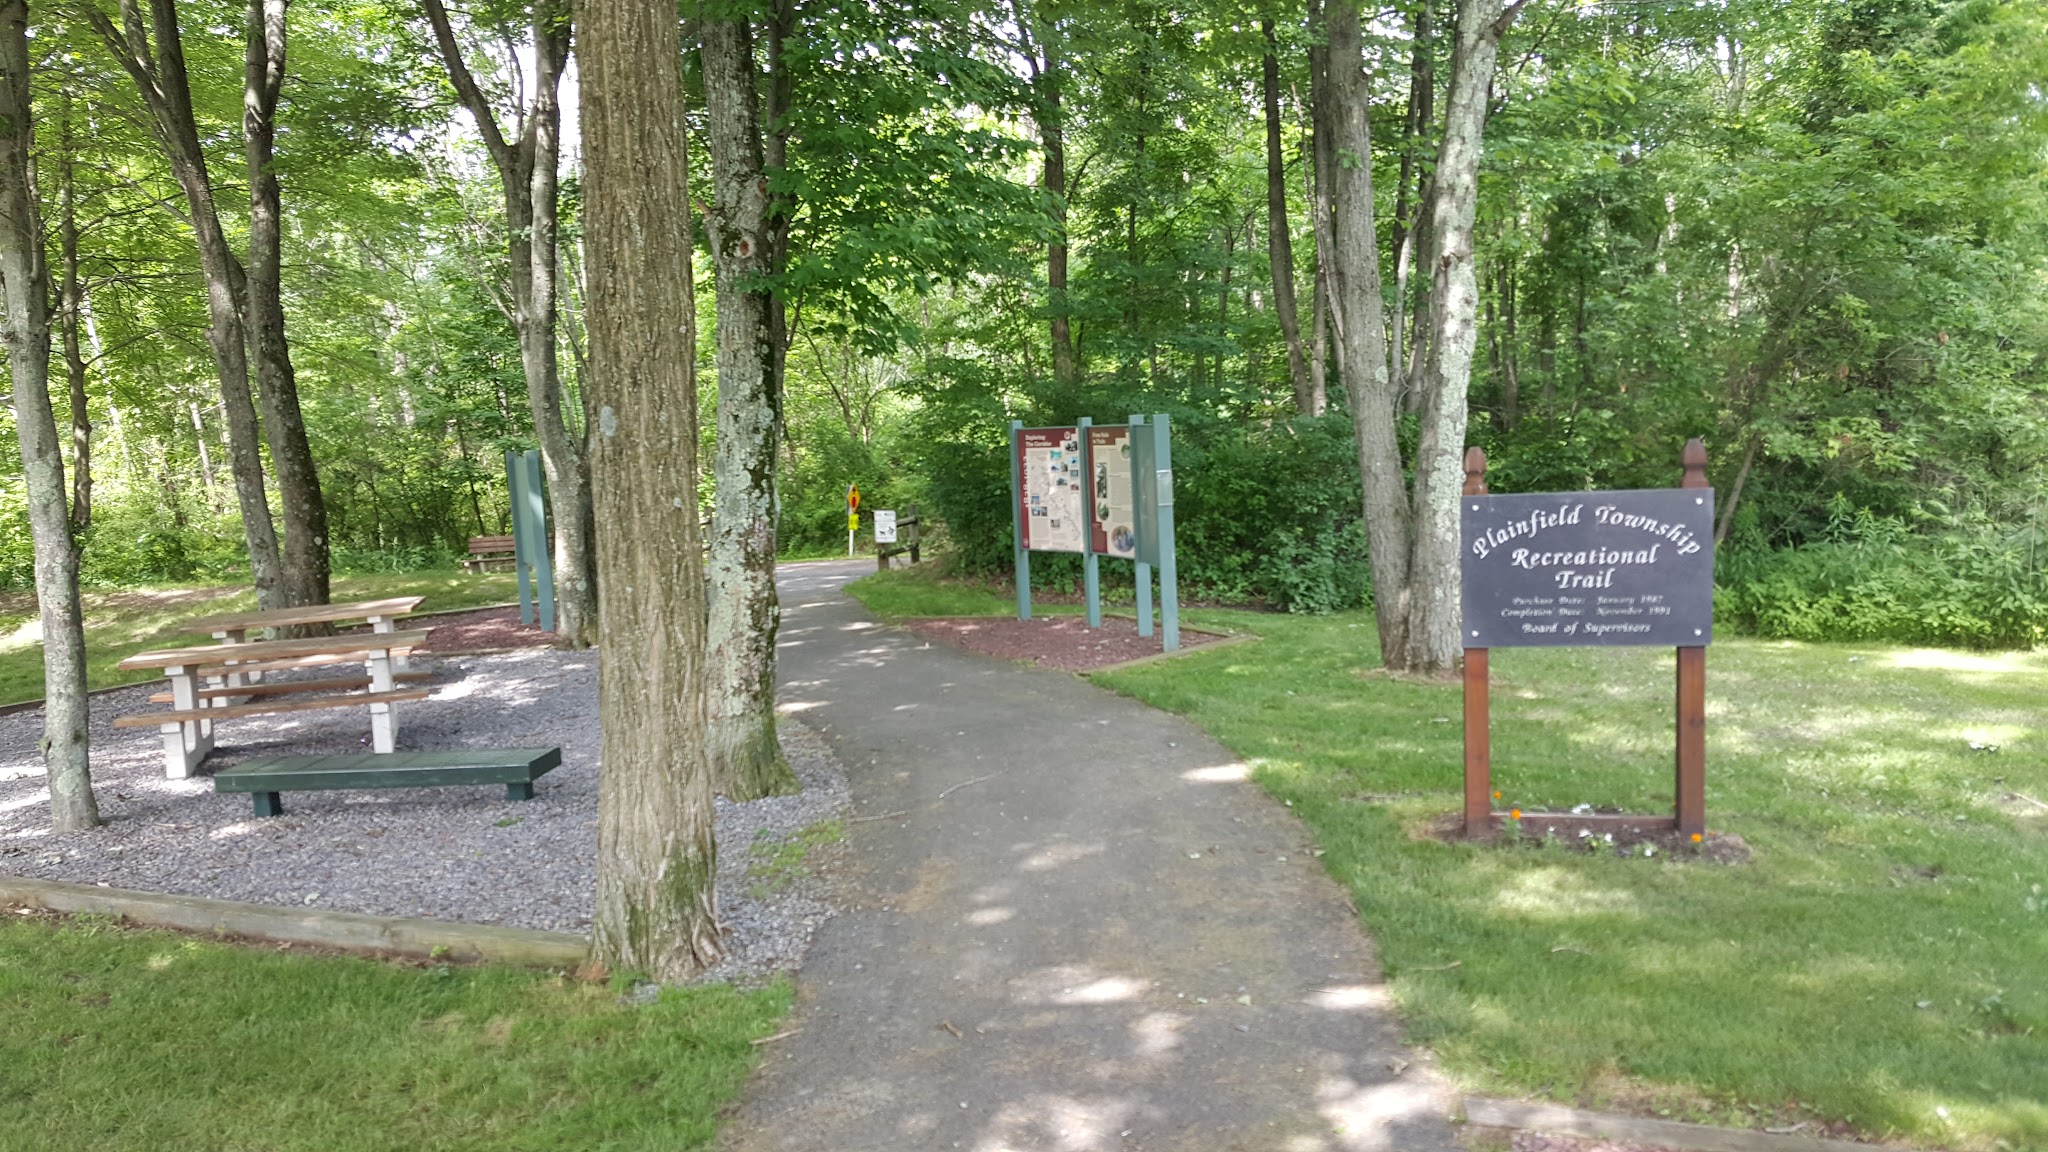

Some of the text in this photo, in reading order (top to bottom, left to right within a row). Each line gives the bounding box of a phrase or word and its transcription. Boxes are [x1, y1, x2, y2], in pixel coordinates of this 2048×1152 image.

[1472, 504, 1701, 559] Plainfield Township
[1511, 543, 1661, 570] Recreational
[1555, 568, 1616, 589] Trail
[1521, 620, 1652, 636] Board of Supervisors
